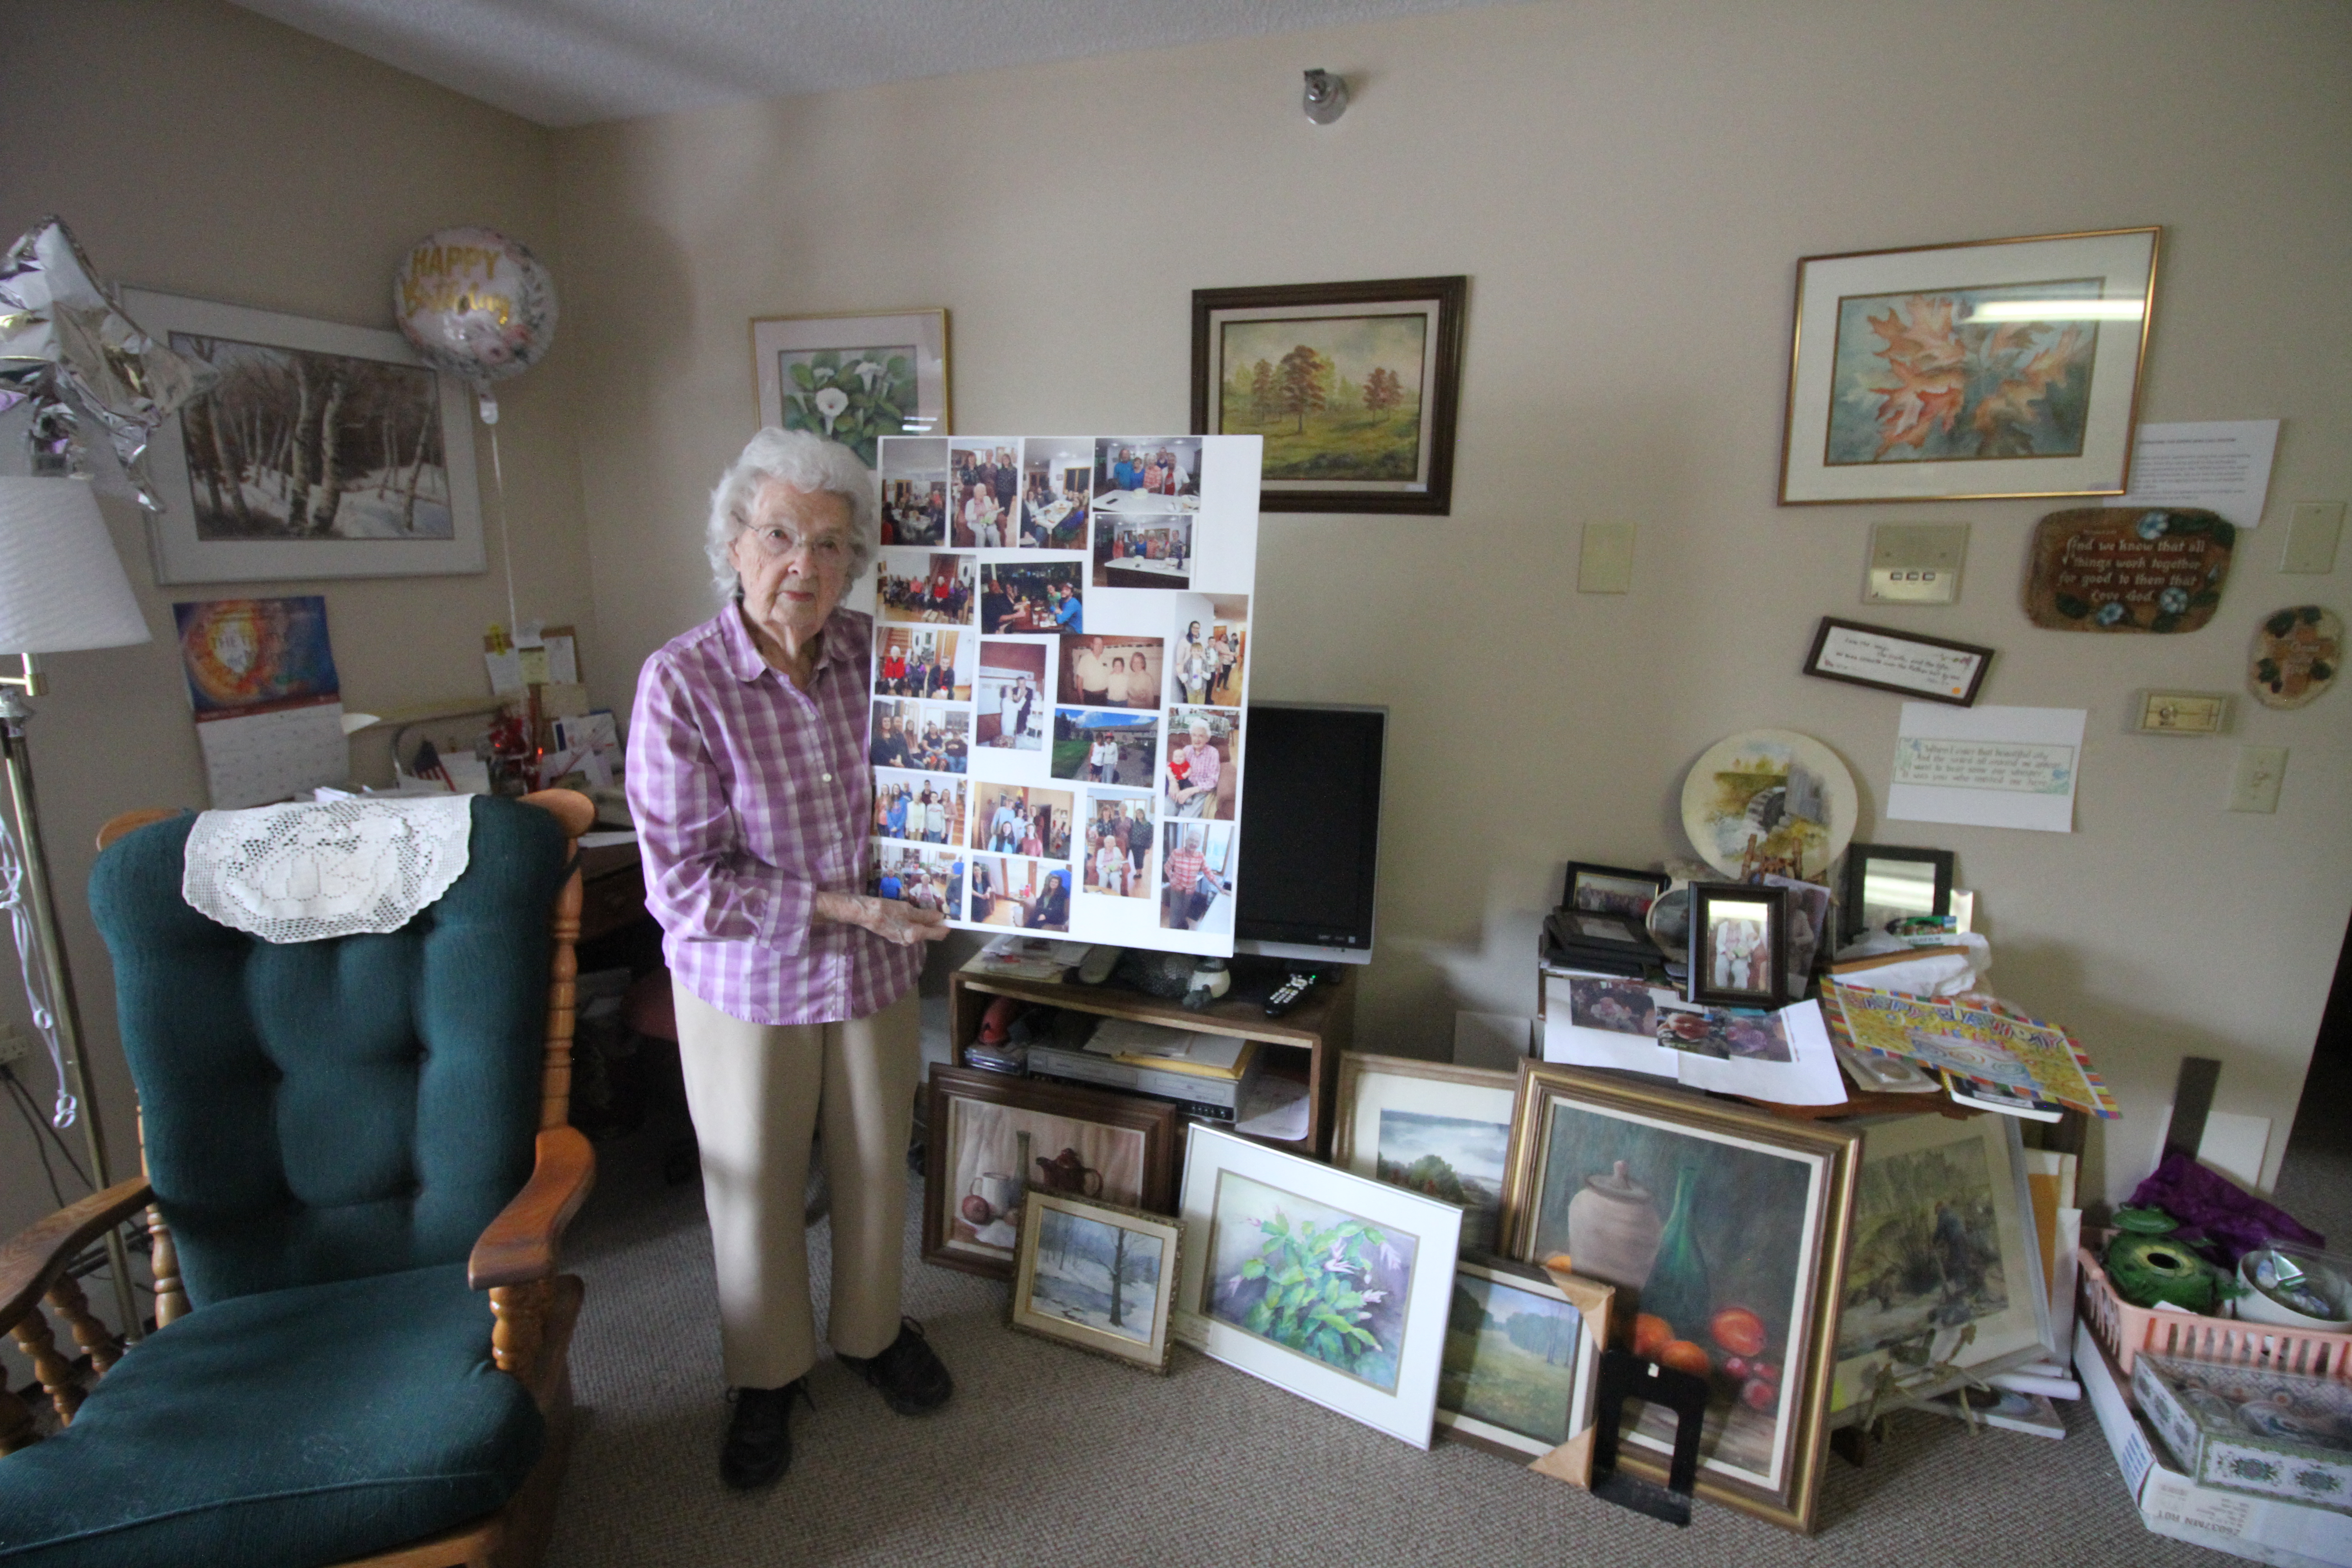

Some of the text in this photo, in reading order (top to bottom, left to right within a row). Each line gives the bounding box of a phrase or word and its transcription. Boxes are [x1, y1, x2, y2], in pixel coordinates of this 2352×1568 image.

[412, 246, 501, 279] HAPPY
[2099, 542, 2115, 551] we
[2120, 539, 2153, 552] know
[2157, 540, 2185, 552] that
[2189, 540, 2205, 553] all
[2074, 557, 2200, 573] things work together
[2057, 571, 2197, 587] for good to them that
